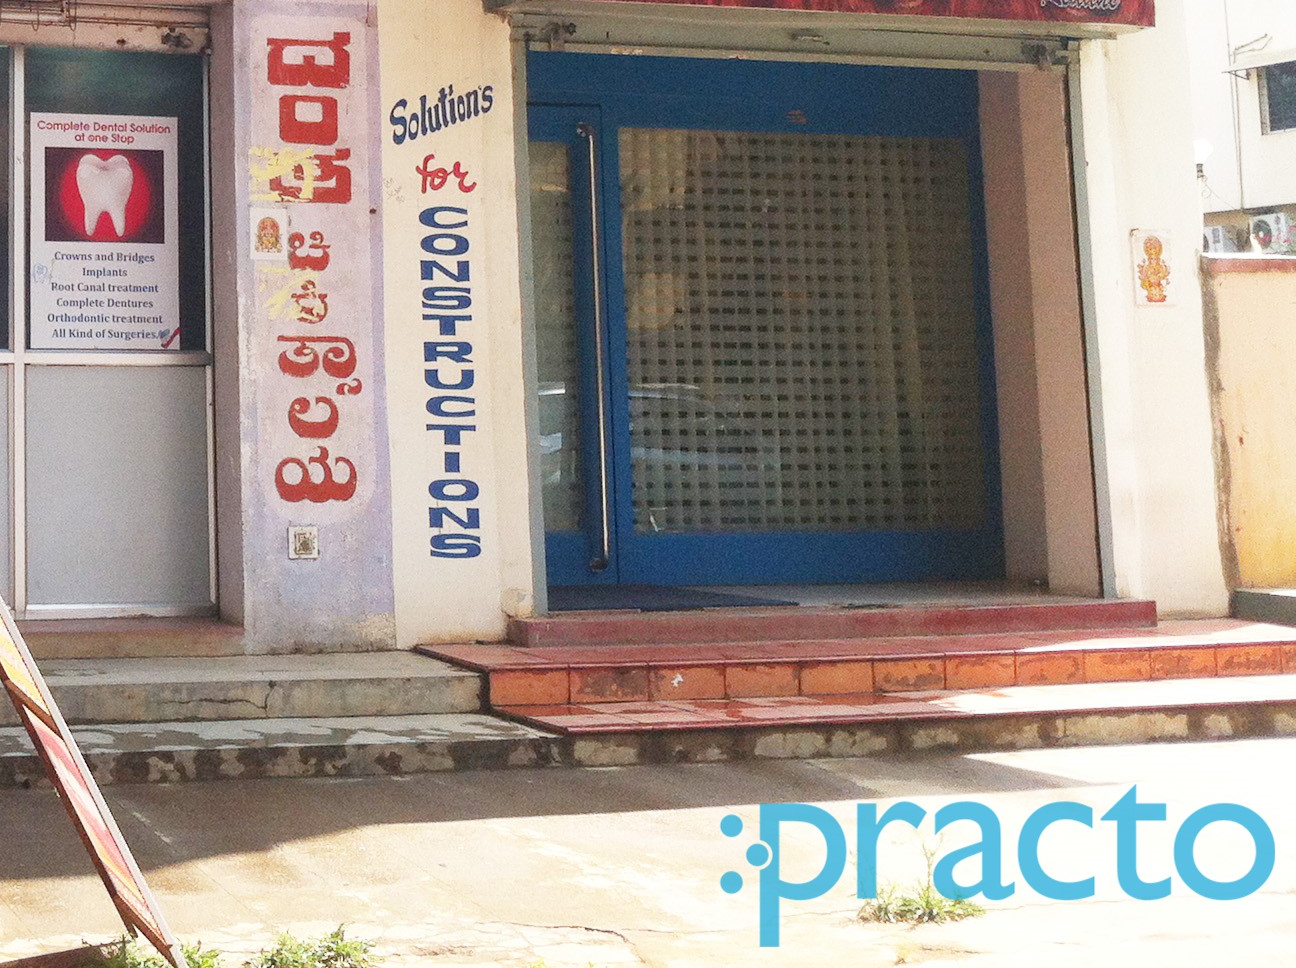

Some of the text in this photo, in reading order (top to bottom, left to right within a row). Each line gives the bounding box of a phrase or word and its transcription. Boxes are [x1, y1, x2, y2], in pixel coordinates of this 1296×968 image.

[37, 120, 171, 134] Complete Dental Solution
[75, 133, 135, 145] at one Stop
[415, 153, 477, 194] for
[54, 251, 155, 264] Crowns and Bridges
[82, 267, 128, 279] Implants
[51, 282, 159, 293] Root Canal treatment
[56, 297, 154, 309] Complete Dentures
[47, 313, 163, 324] Orthodontic treatment
[52, 328, 66, 339] All
[69, 328, 93, 339] Kind
[95, 328, 106, 339] of
[417, 206, 482, 560] CONSTRUCTIONS
